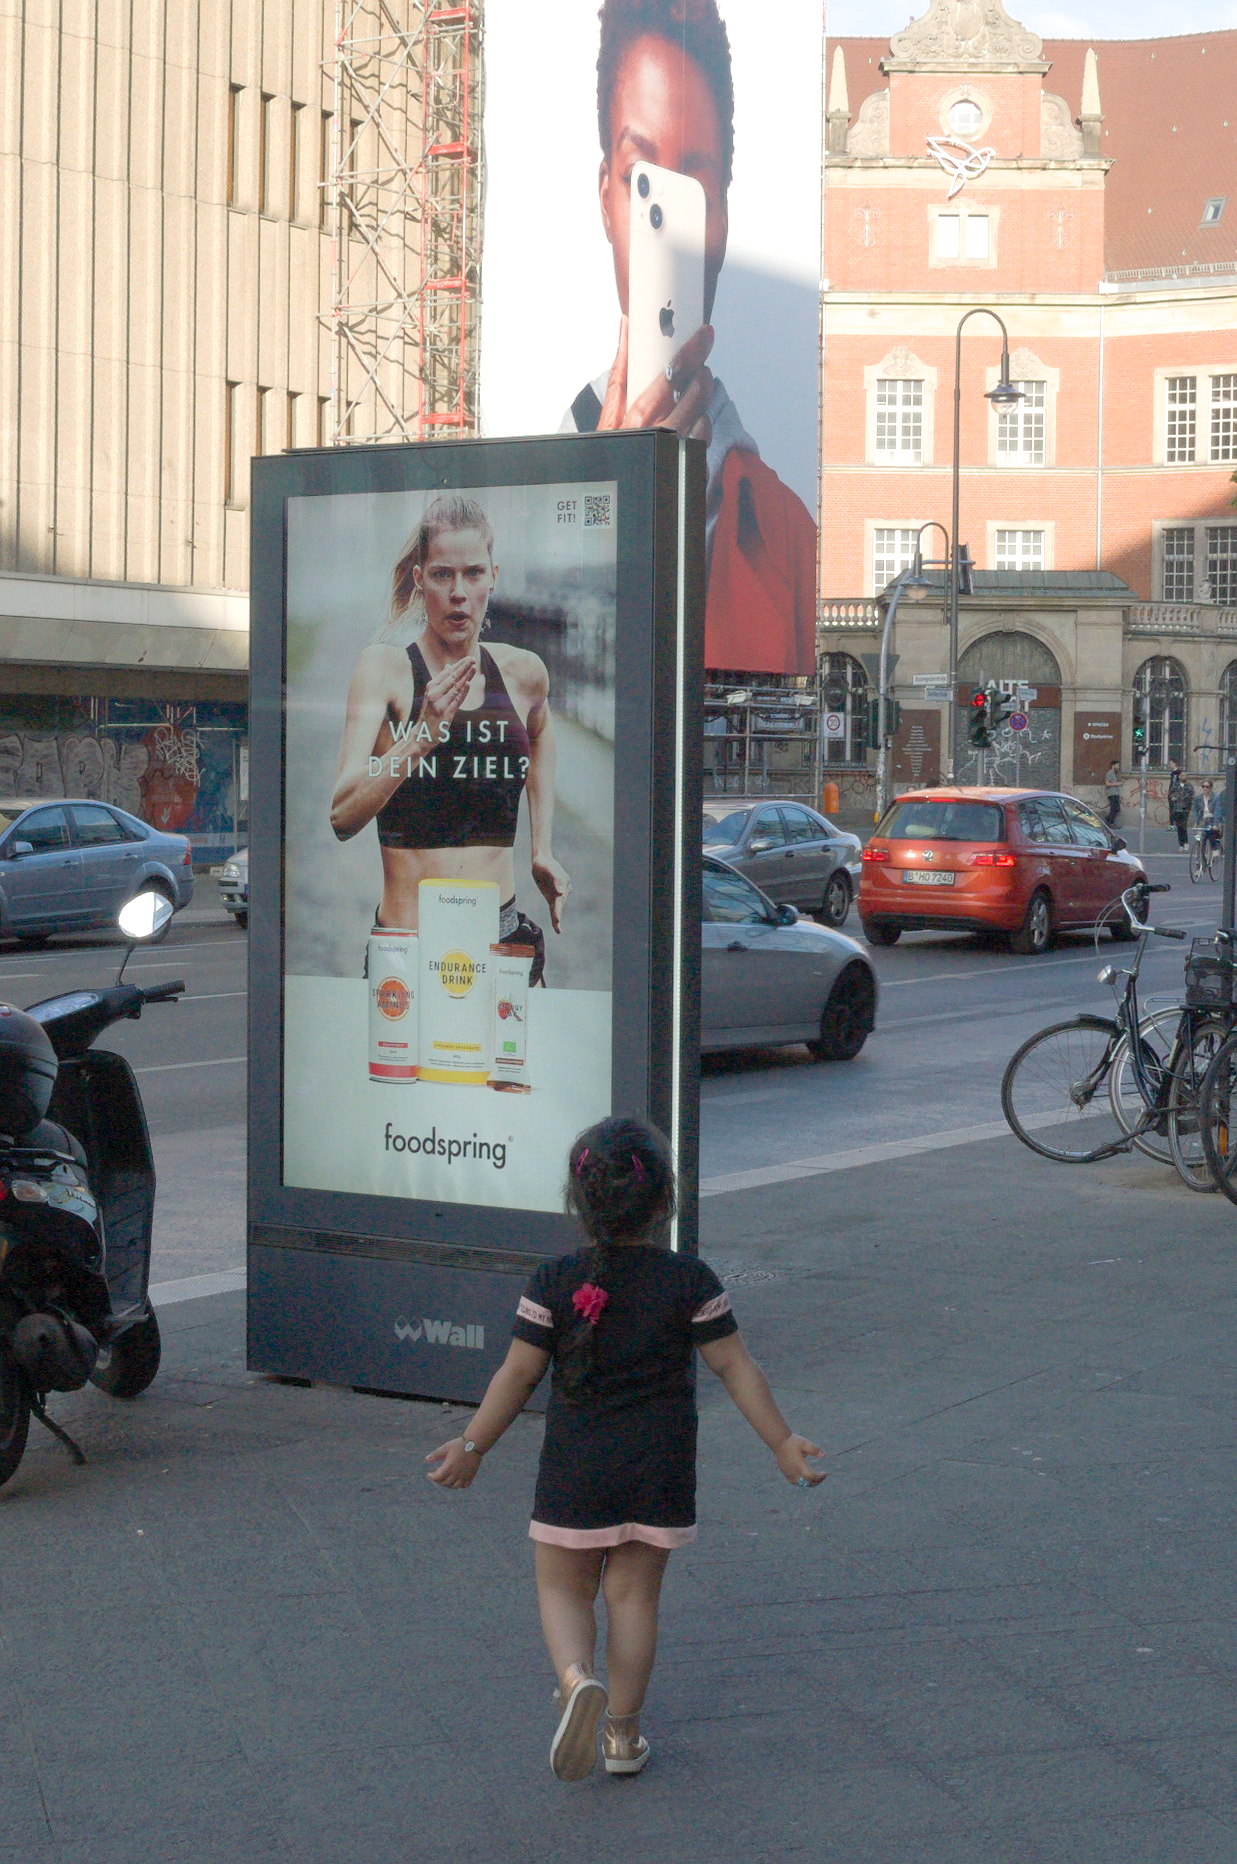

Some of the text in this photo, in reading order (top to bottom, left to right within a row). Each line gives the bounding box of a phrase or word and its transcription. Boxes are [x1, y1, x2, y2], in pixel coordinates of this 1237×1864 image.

[557, 500, 577, 511] GET
[557, 513, 576, 524] FIT!
[389, 720, 509, 743] WAS IST
[368, 756, 531, 780] DEIN ZIEL?
[439, 894, 477, 907] foodspring
[429, 960, 487, 974] ENDURANCE
[442, 974, 473, 986] DRINK
[422, 1318, 485, 1350] Wall
